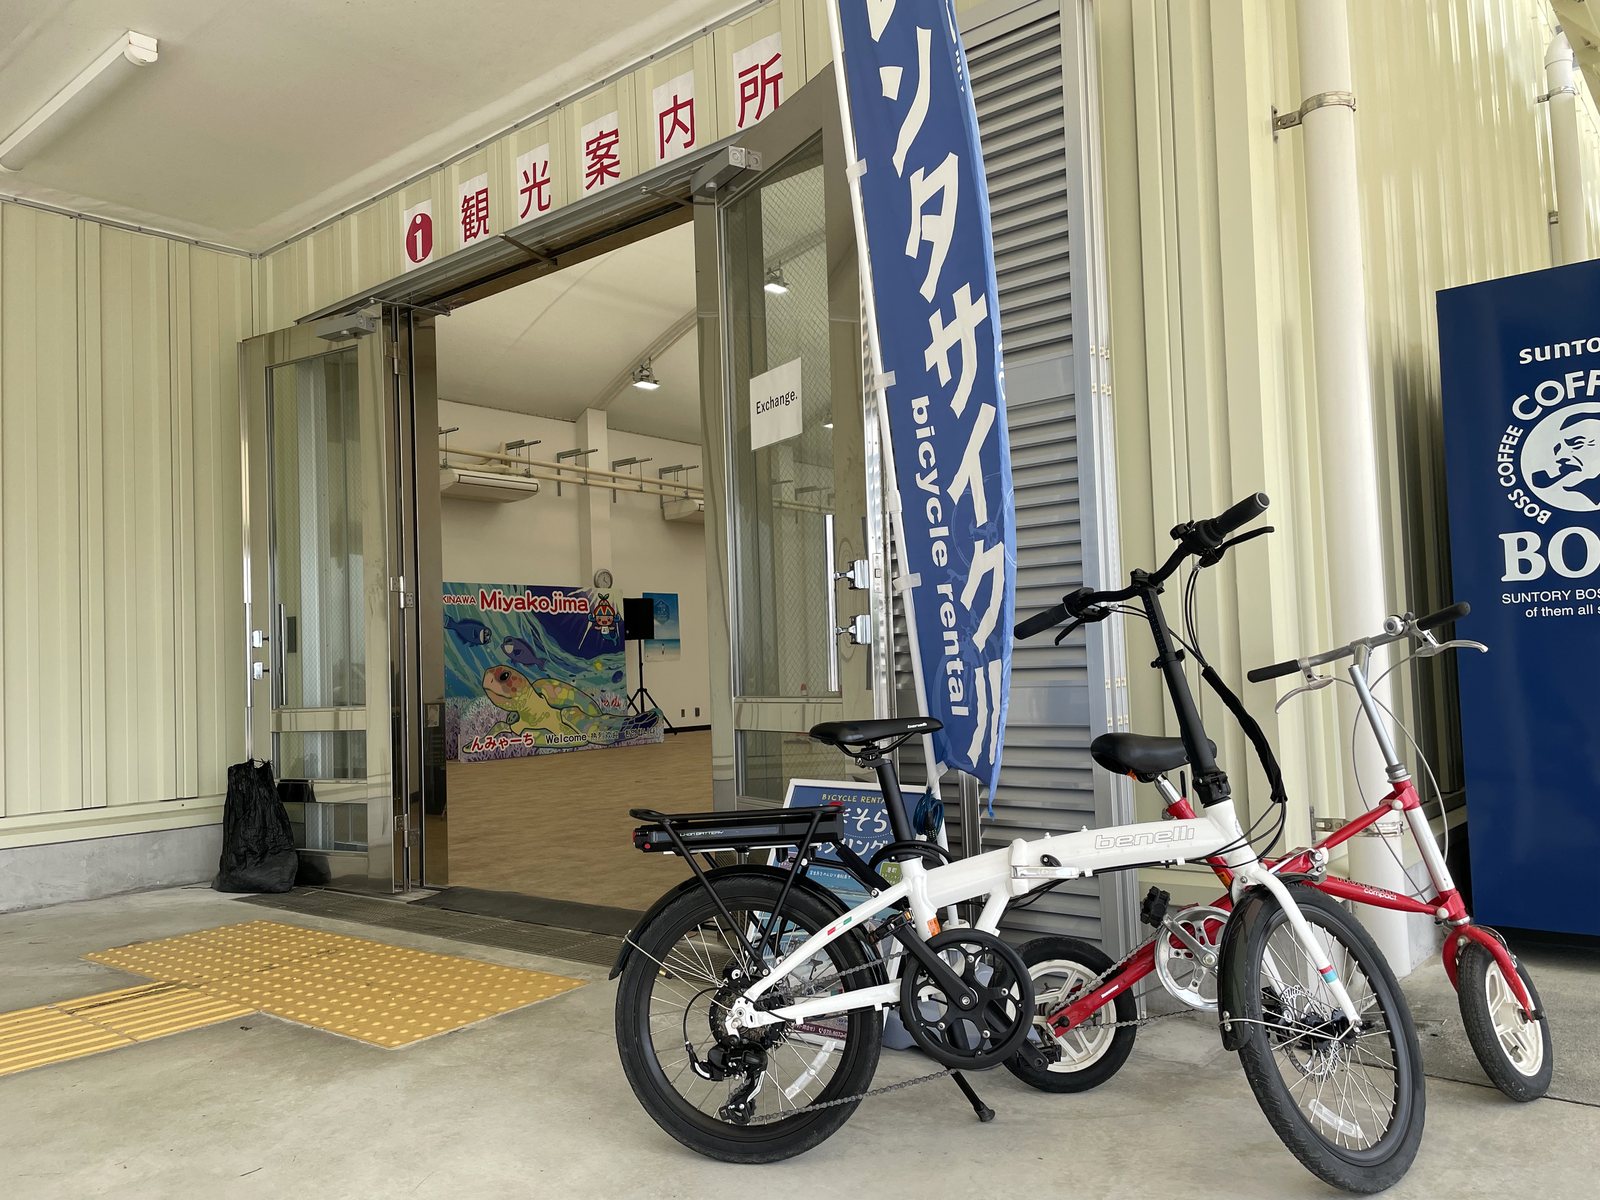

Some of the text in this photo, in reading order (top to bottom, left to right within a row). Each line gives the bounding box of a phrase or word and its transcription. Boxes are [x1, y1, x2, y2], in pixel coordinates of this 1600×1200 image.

[461, 52, 783, 243] 観光案内所
[756, 390, 798, 415] Exchange.
[1497, 424, 1552, 525] BOSS COFFEE
[911, 395, 969, 717] bicycle rental
[1498, 526, 1600, 582] BO
[480, 591, 589, 614] Miyakojima
[1501, 590, 1571, 604] SUNTORY
[1525, 606, 1538, 617] of
[1541, 606, 1574, 617] them
[1577, 604, 1594, 615] all
[471, 733, 534, 751] んみゃーち
[545, 734, 587, 744] Welcome
[822, 793, 857, 803] BICYCLE
[1095, 825, 1195, 849] benelli
[1364, 888, 1397, 900] compact
